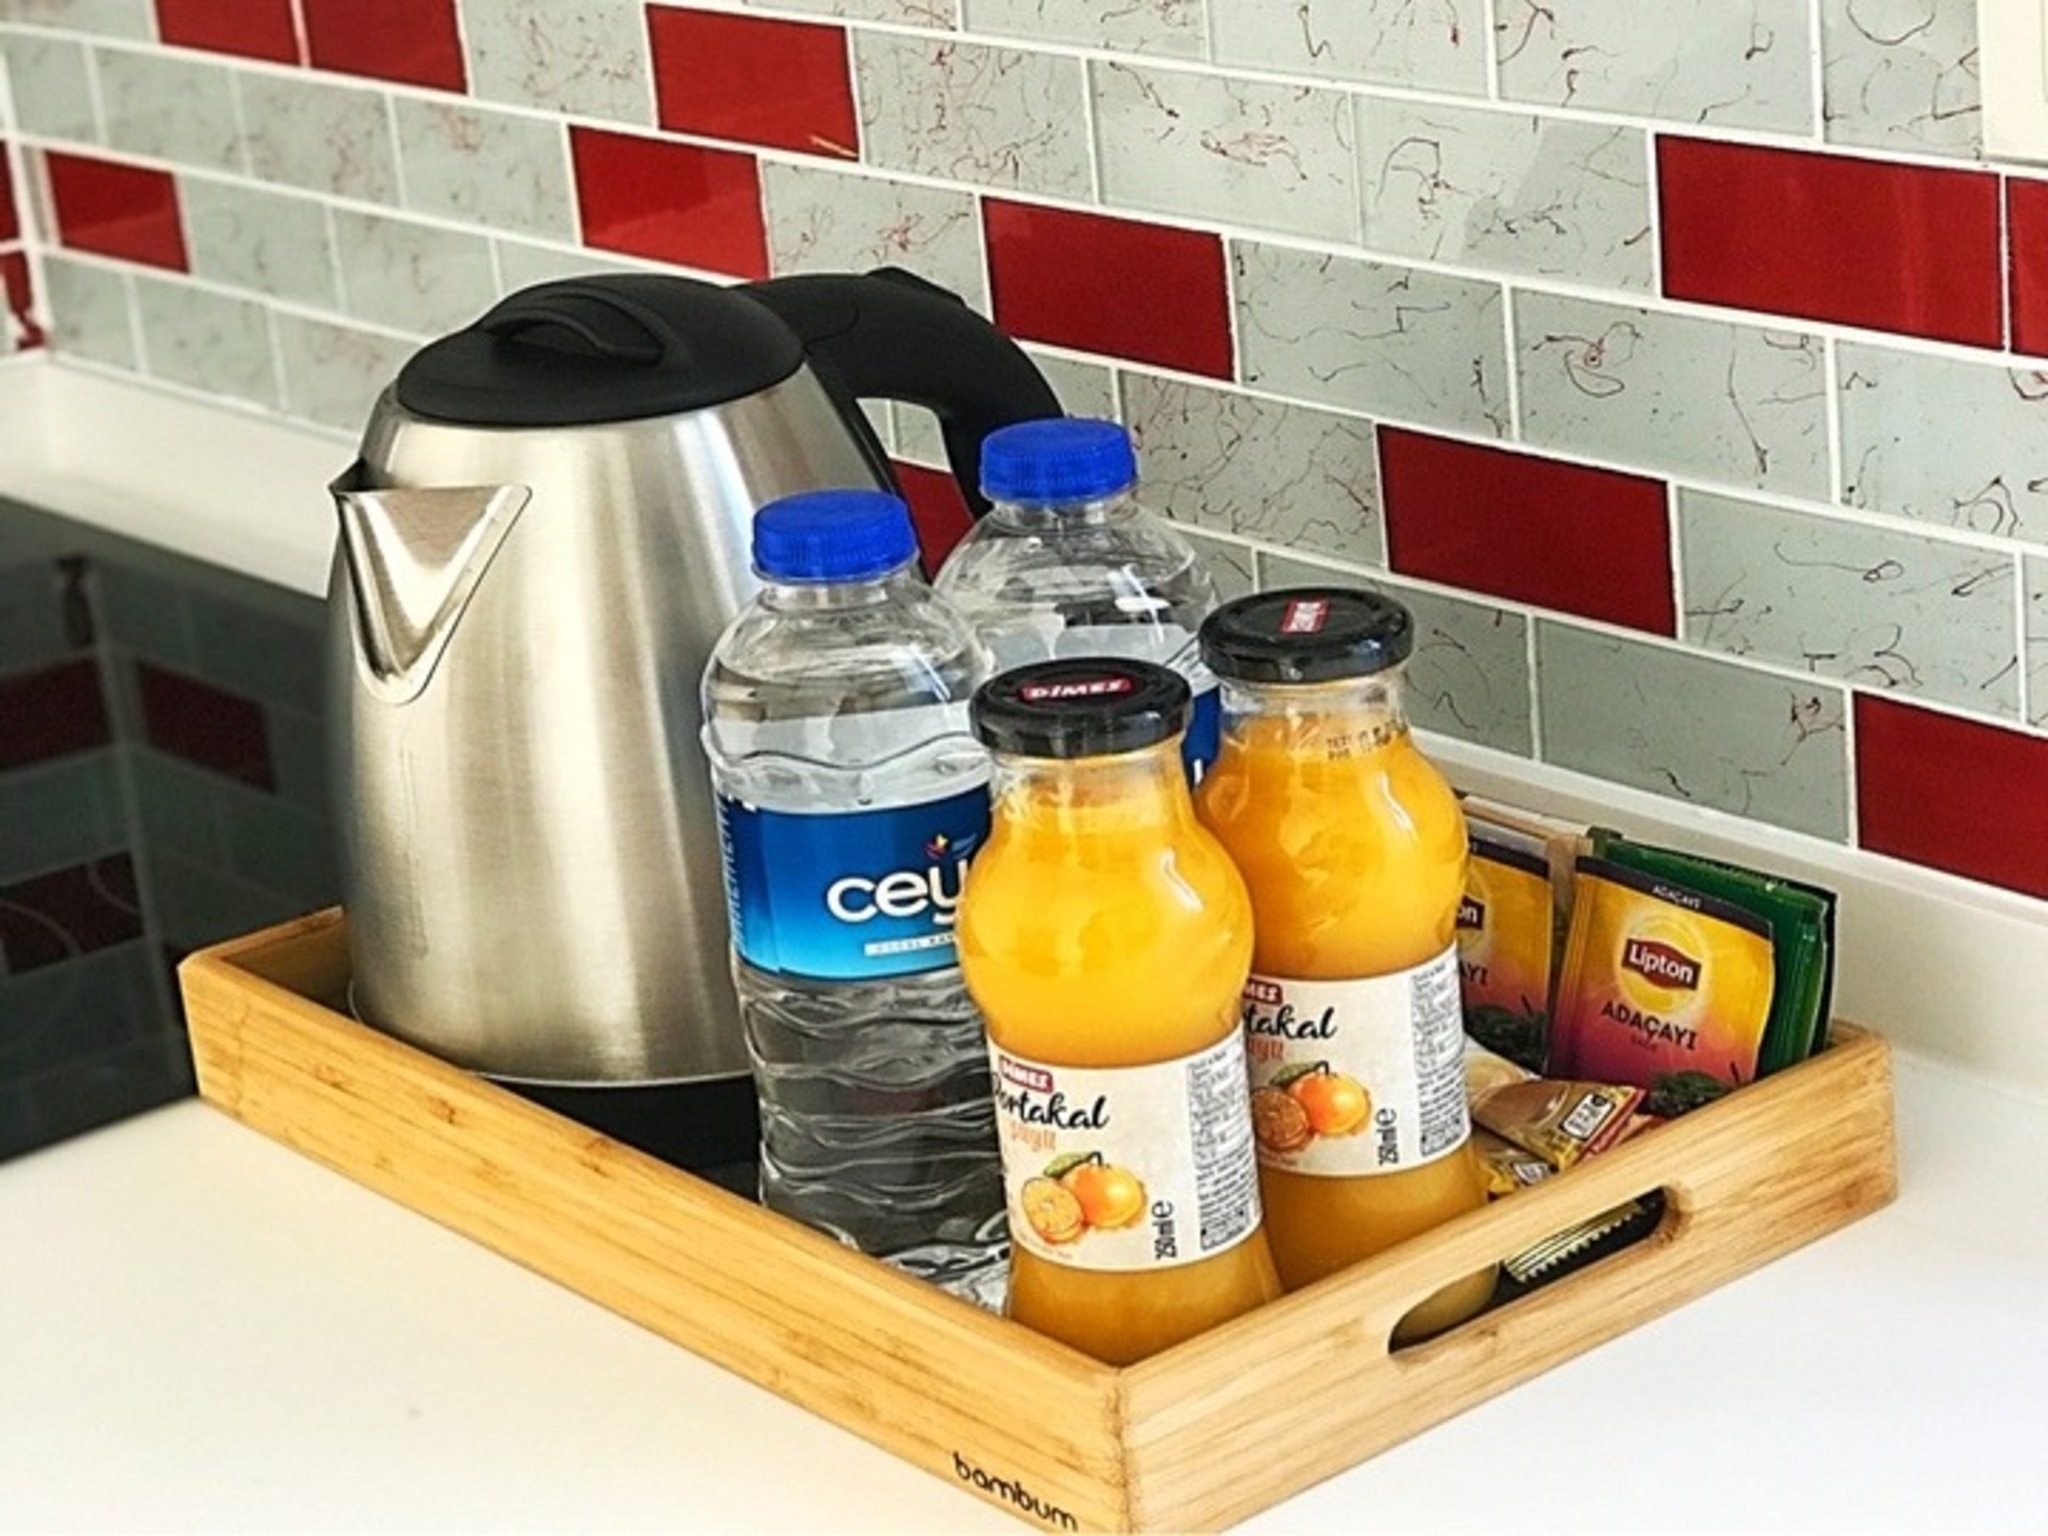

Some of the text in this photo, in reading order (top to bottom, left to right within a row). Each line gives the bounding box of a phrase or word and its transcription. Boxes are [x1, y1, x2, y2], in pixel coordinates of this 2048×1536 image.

[1629, 943, 1694, 984] Lipton
[1243, 1004, 1338, 1040] takal
[1601, 1001, 1697, 1050] ADAÇAYI
[952, 1450, 1078, 1532] bambum
